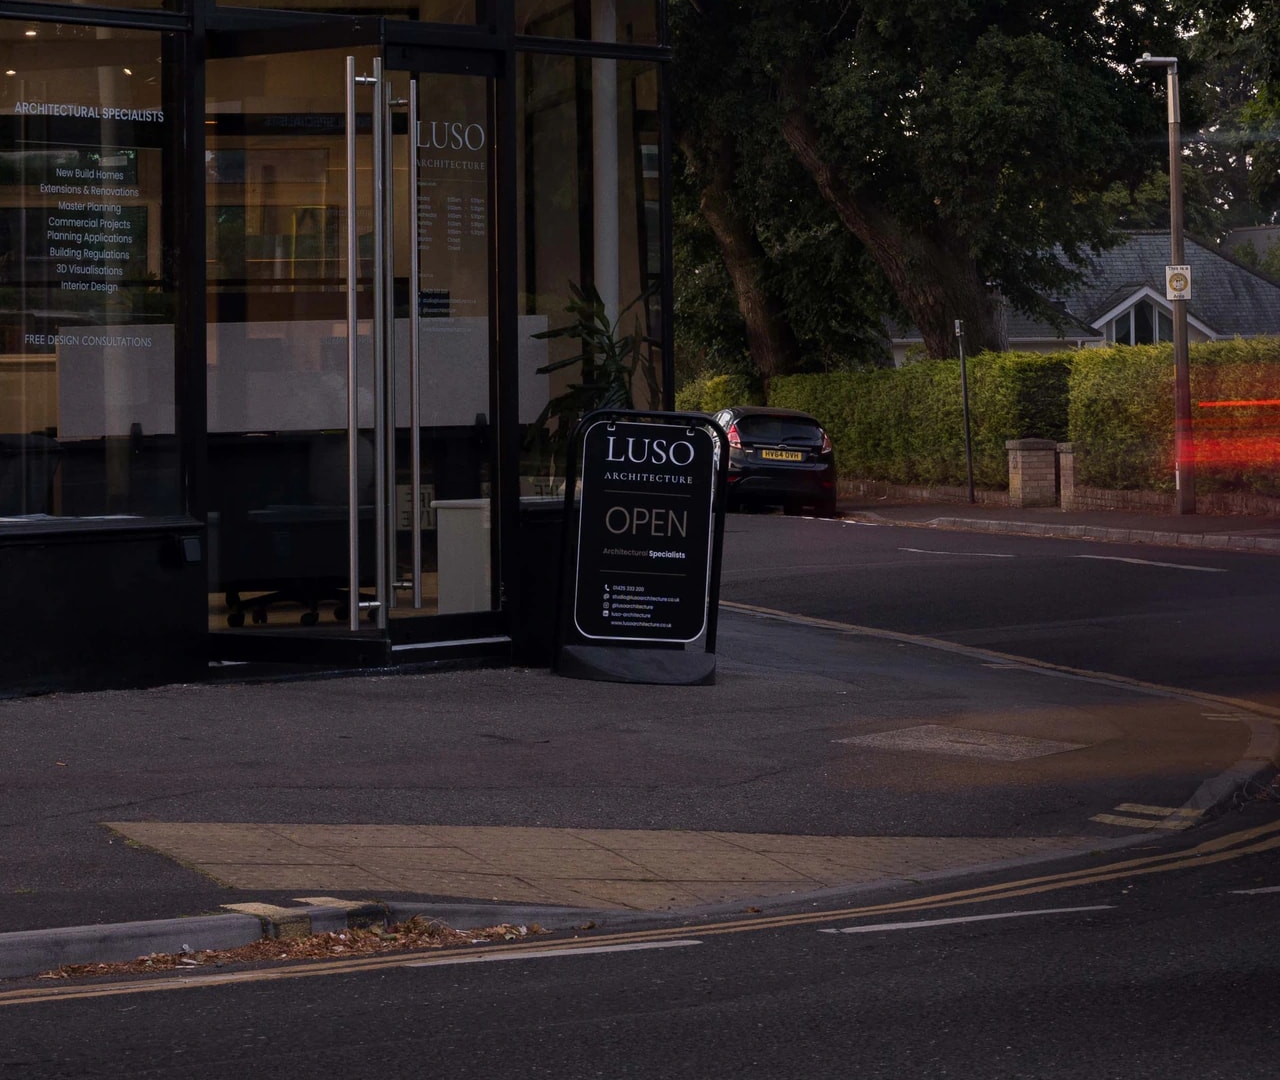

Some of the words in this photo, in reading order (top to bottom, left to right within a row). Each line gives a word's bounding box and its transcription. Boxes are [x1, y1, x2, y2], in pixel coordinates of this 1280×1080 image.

[15, 102, 100, 118] ARCHITECTURAL
[102, 107, 164, 123] SPECIALISTS
[417, 121, 485, 151] LUSO
[56, 168, 73, 178] New
[75, 168, 94, 179] Build
[96, 169, 124, 180] Homes
[40, 183, 81, 195] Extensions
[83, 185, 90, 194] &
[91, 186, 139, 197] Renovations
[58, 201, 85, 211] Master
[87, 202, 121, 215] Planning
[48, 217, 98, 228] Commercial
[100, 218, 131, 231] Projects
[47, 231, 82, 244] Planning
[84, 233, 132, 244] Applications
[49, 247, 82, 260] Building
[83, 248, 130, 261] Regulations
[56, 264, 67, 273] 3D
[68, 264, 123, 276] Visualisations
[61, 281, 89, 291] Interior
[91, 282, 118, 294] Design
[24, 334, 45, 345] FREE
[47, 335, 79, 345] DESIGN
[81, 336, 152, 347] CONSULTATIONS
[605, 436, 695, 466] LUSO
[604, 472, 693, 484] ARCHITECTURE
[605, 506, 687, 538] OPEN
[603, 547, 649, 557] Architectural
[649, 550, 686, 559] Specialists
